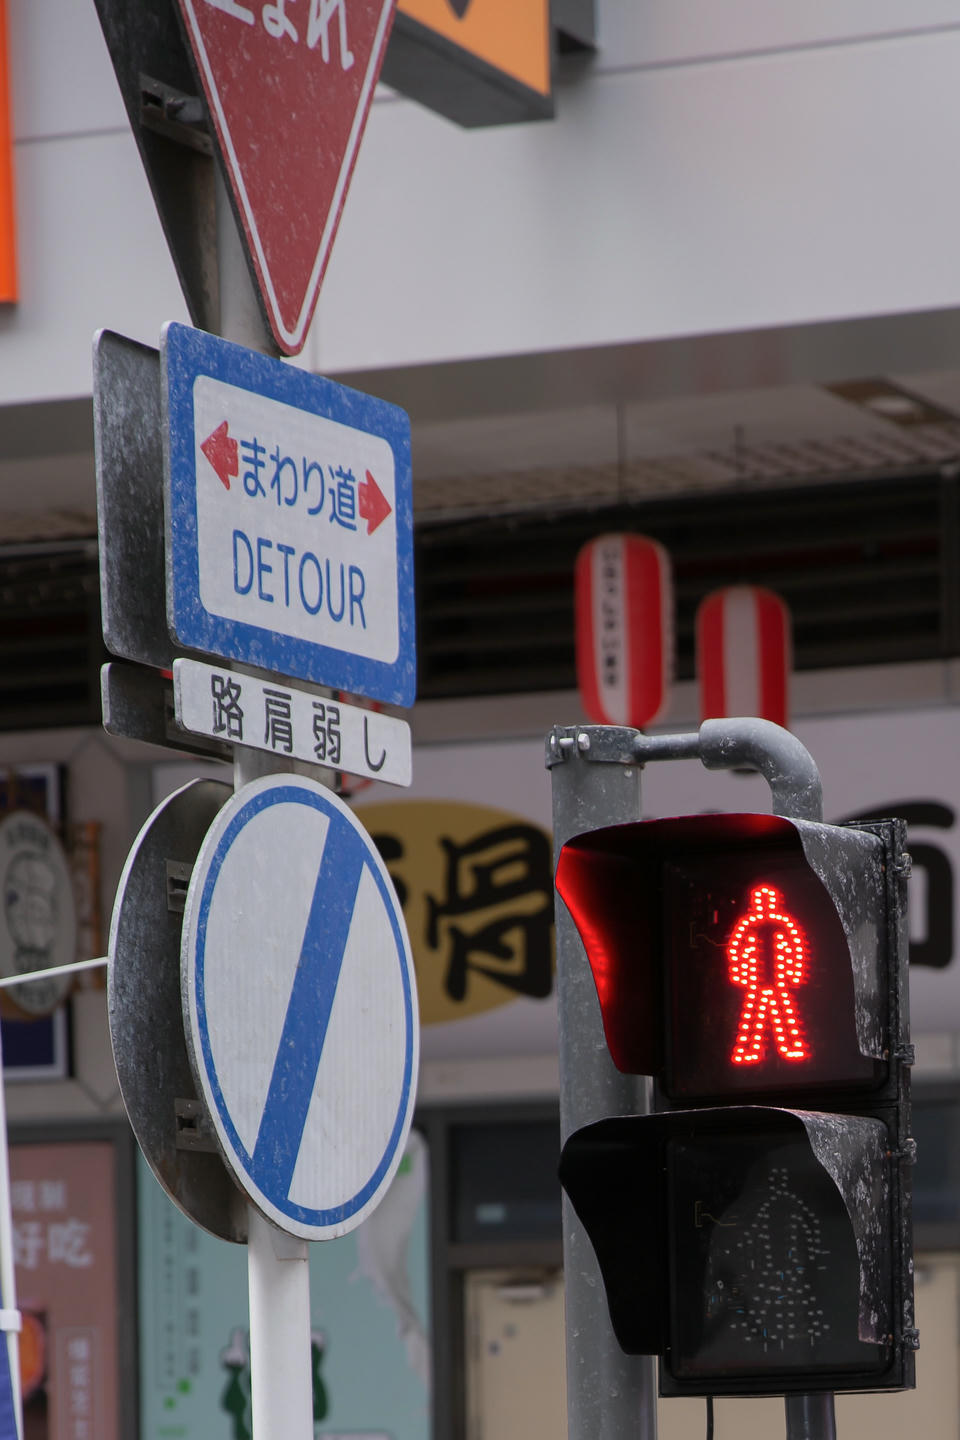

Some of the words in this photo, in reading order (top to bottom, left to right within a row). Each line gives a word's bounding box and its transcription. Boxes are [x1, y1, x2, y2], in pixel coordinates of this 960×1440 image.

[203, 0, 355, 71] まれ
[240, 437, 357, 531] まわり道
[232, 529, 367, 630] DETOUR
[210, 673, 387, 773] 路肩弱し
